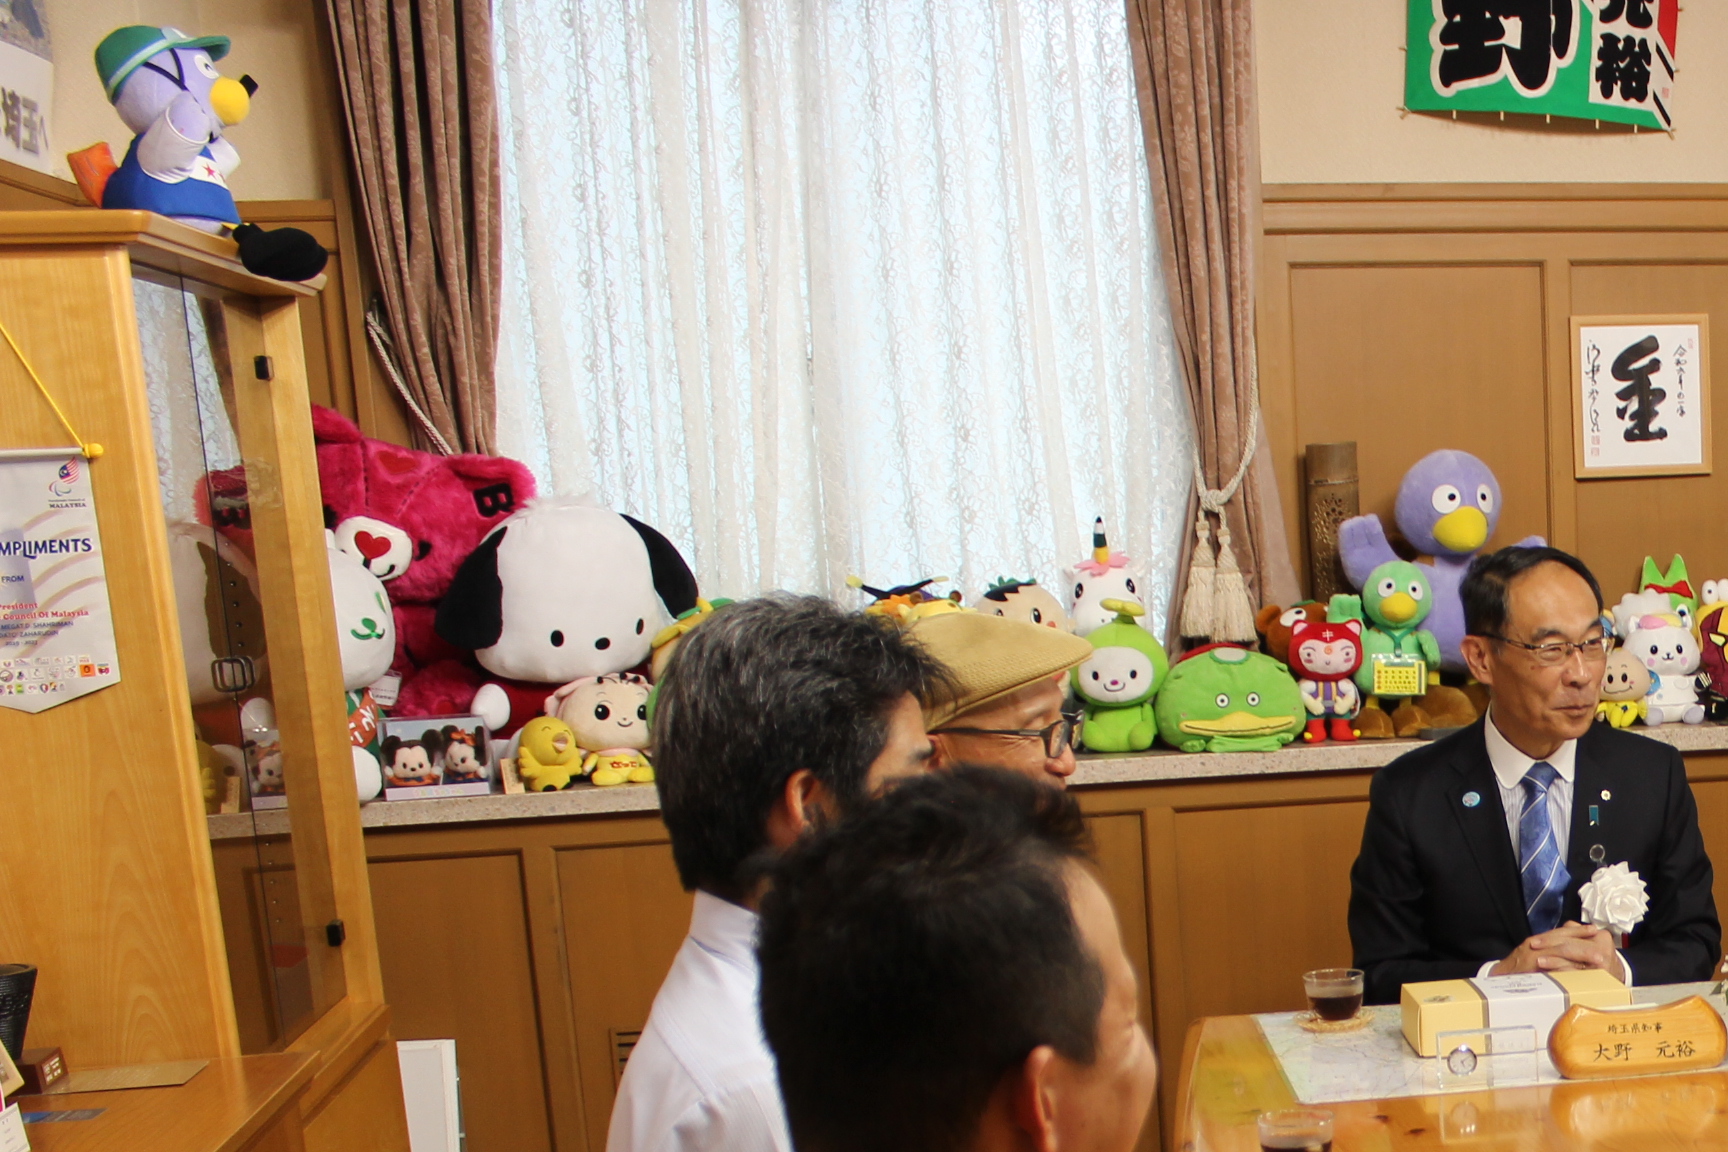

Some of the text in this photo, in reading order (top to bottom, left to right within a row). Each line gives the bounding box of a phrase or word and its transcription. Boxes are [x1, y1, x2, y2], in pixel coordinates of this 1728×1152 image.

[3, 612, 36, 620] Council
[51, 610, 89, 618] Malaysia
[1607, 1022, 1663, 1034] 埼玉県知事
[1594, 1040, 1697, 1062] 大野 元裕
